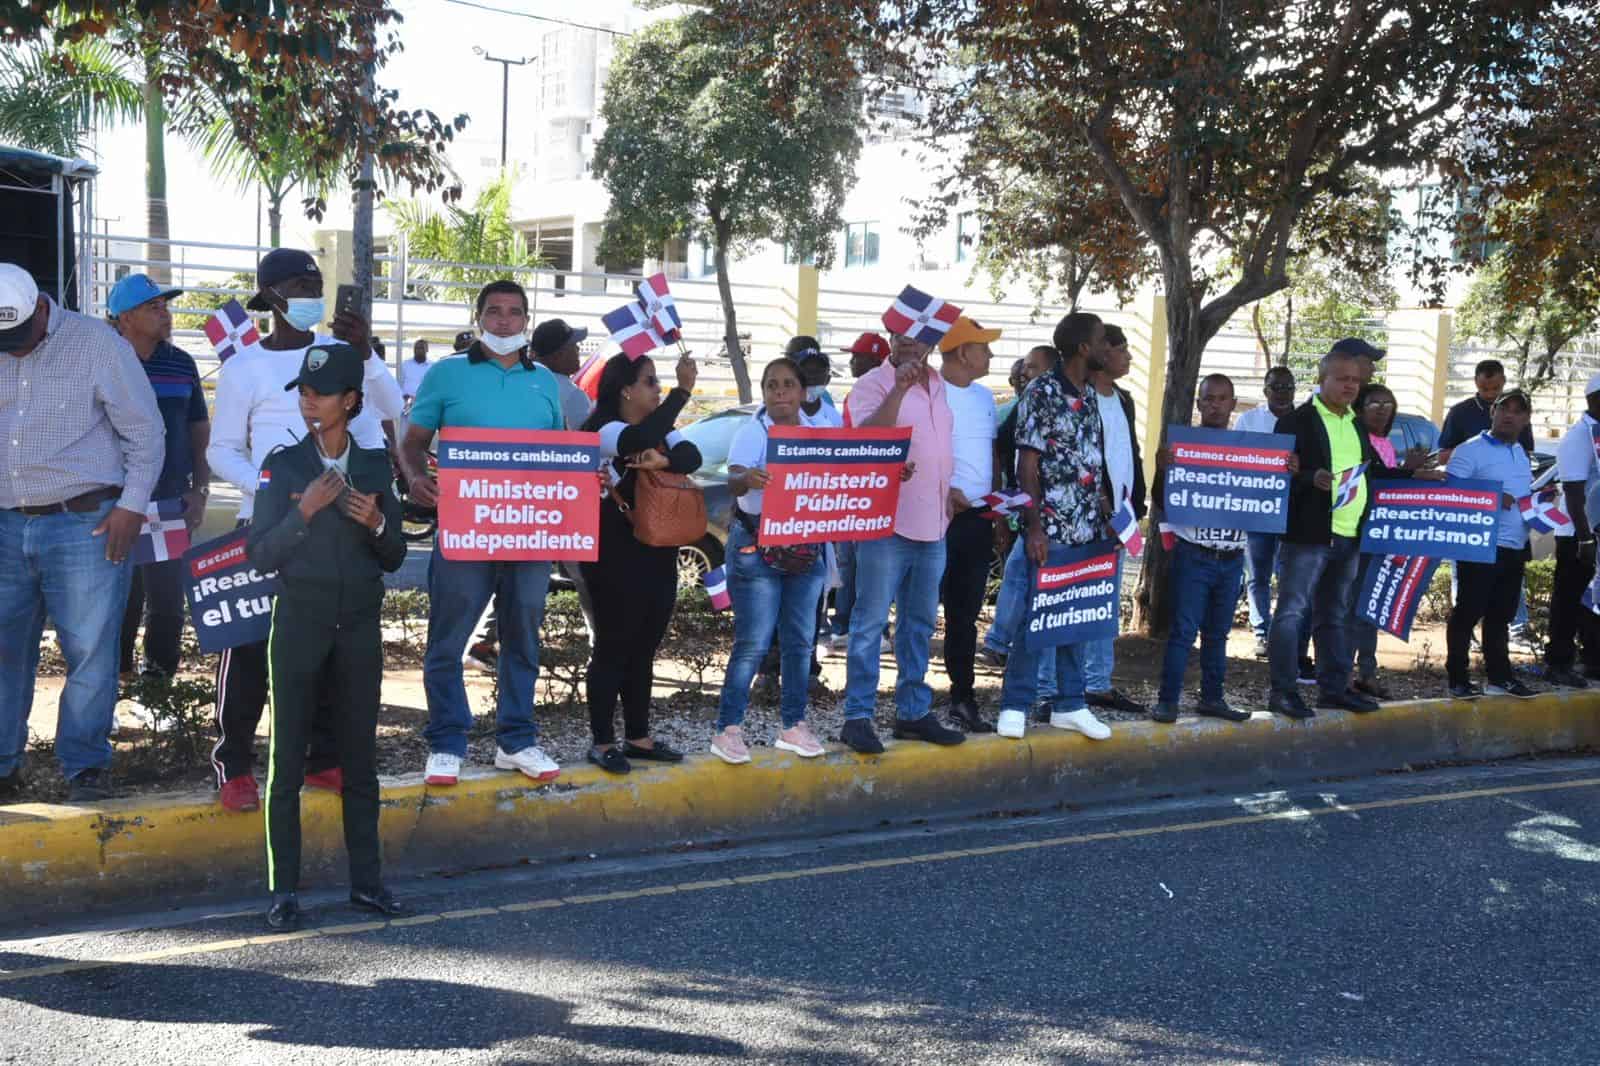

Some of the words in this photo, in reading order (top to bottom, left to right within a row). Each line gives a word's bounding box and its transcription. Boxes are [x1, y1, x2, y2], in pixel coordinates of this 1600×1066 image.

[448, 448, 510, 462] Estamos
[512, 450, 590, 464] cambiando
[777, 445, 832, 456] Estamos
[834, 445, 903, 457] cambiando
[1176, 447, 1224, 462] Estamos
[1225, 452, 1286, 466] cambiando
[784, 471, 889, 490] Ministerio
[1168, 467, 1286, 490] ¡Reactivando
[458, 479, 579, 501] Ministerio
[1378, 491, 1427, 501] Estamos
[1427, 492, 1493, 505] cambiando
[795, 493, 873, 513] Público
[1169, 489, 1188, 507] el
[1191, 490, 1282, 514] turismo!
[474, 503, 563, 525] Público
[1369, 506, 1495, 526] ¡Reactivando
[763, 515, 892, 538] Independiente
[1368, 525, 1390, 540] el
[1393, 525, 1491, 547] turismo!
[443, 529, 594, 555] Independiente
[197, 545, 245, 570] Estam
[1040, 571, 1074, 583] Estamos
[1366, 554, 1393, 620] rismo!
[1032, 579, 1114, 612] ¡Reactivando
[202, 600, 232, 627] el
[235, 595, 271, 619] tu
[1029, 611, 1045, 632] el
[1046, 601, 1113, 629] turismo!
